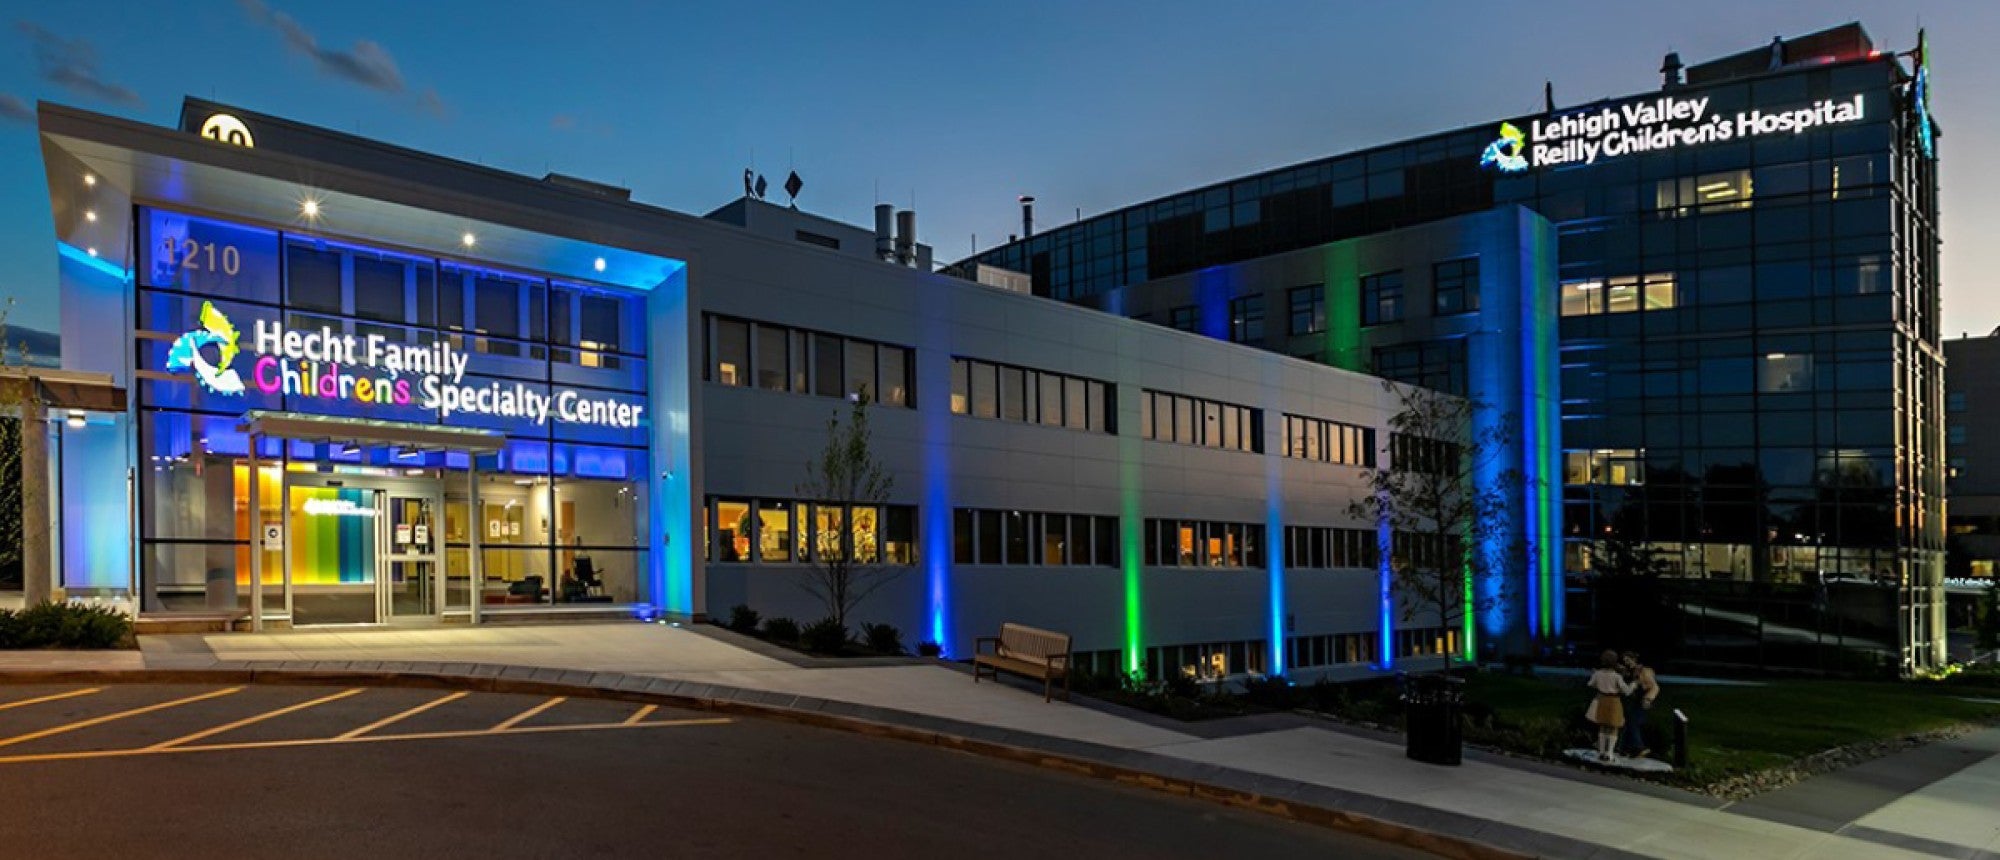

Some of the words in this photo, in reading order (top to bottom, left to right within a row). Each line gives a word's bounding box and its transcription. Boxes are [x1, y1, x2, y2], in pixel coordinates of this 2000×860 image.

[1532, 107, 1620, 142] Lehigh
[1621, 95, 1709, 127] Valley
[1532, 137, 1600, 167] Reilly
[1602, 113, 1733, 157] Children's
[1737, 93, 1864, 134] Hospital
[165, 237, 240, 276] 1210
[256, 319, 356, 366] Hecht
[367, 333, 468, 384] Family
[423, 375, 551, 426] Specialty
[558, 391, 643, 427] Center
